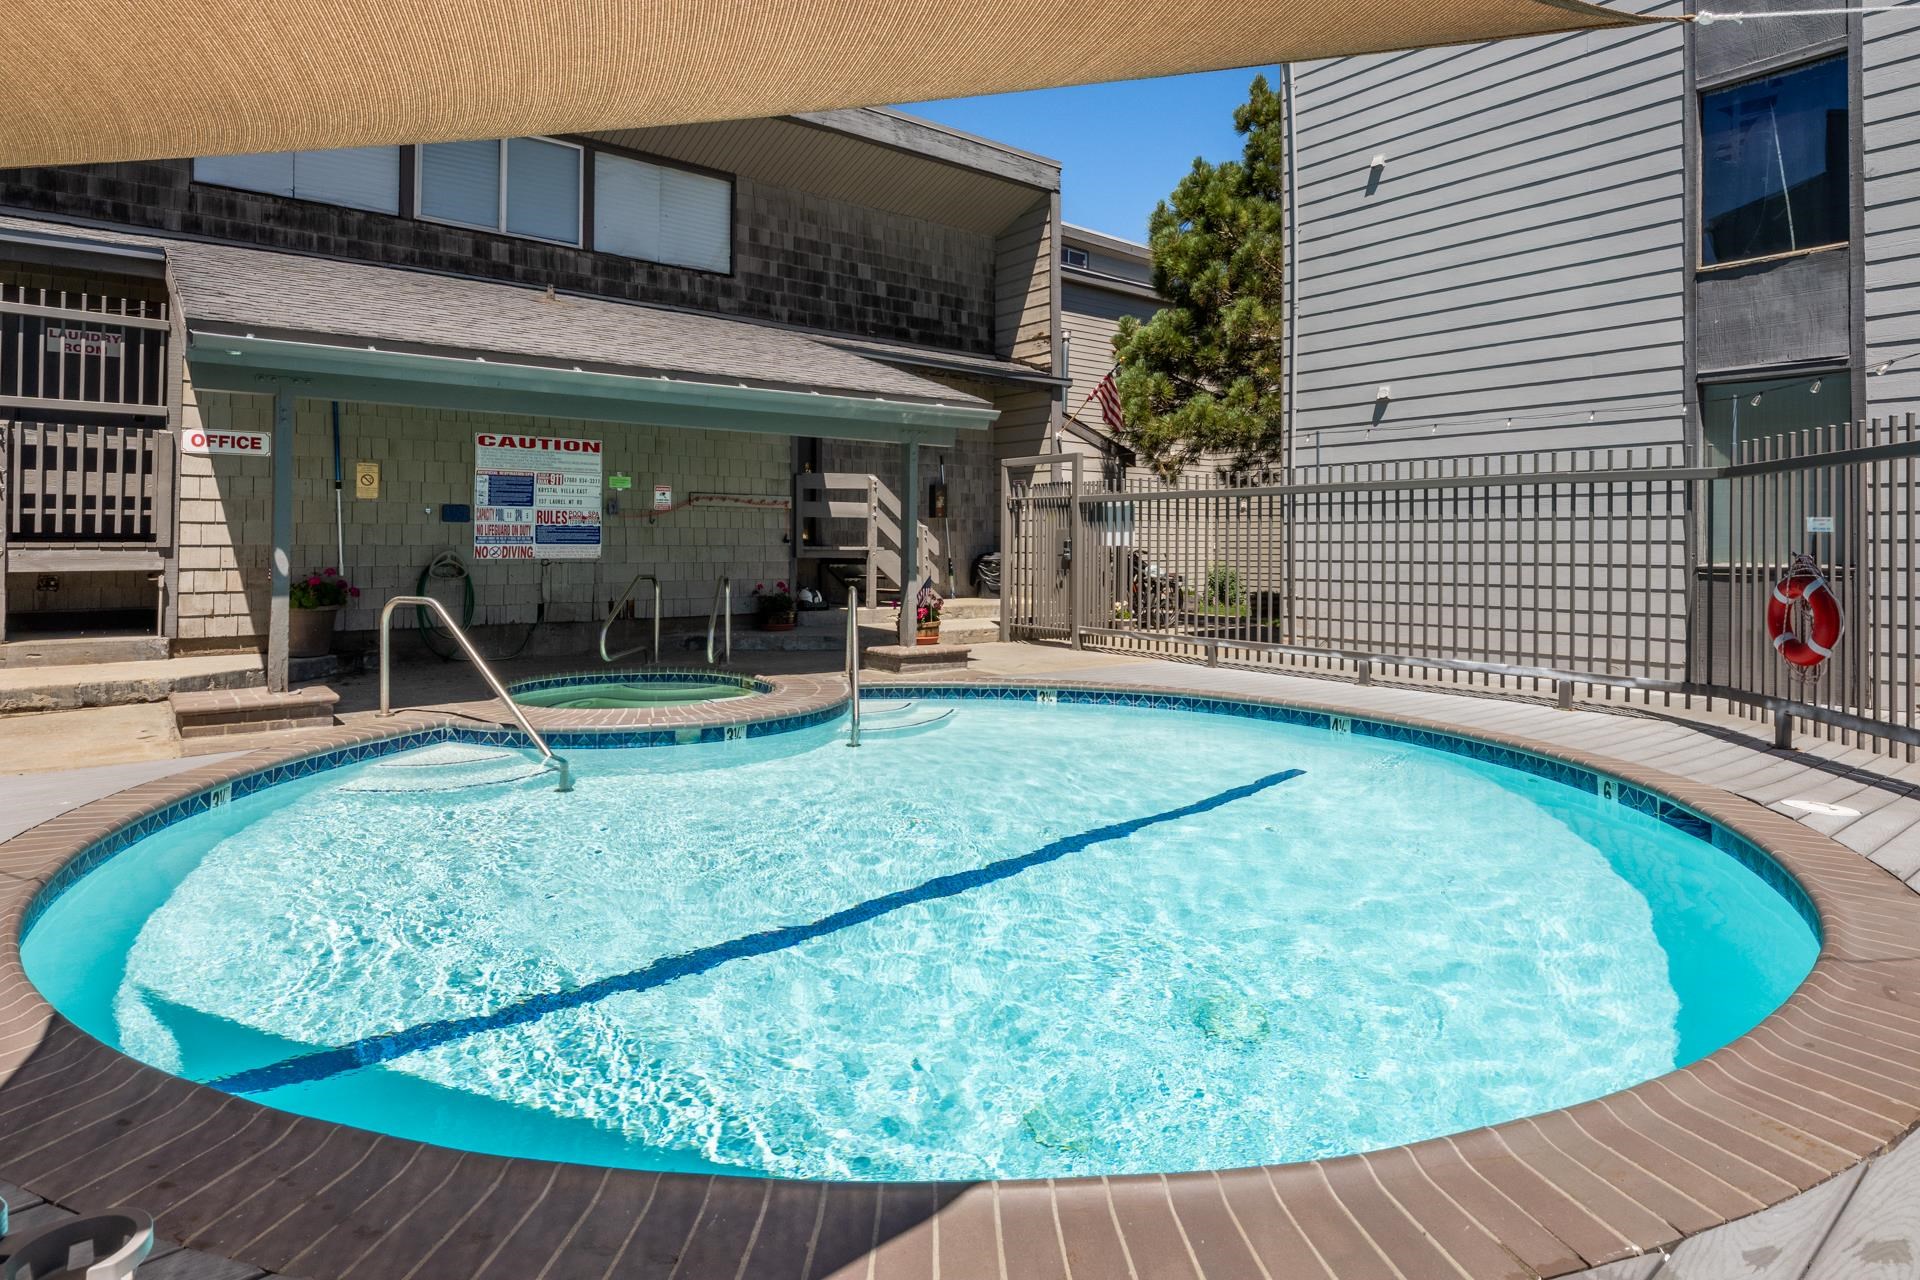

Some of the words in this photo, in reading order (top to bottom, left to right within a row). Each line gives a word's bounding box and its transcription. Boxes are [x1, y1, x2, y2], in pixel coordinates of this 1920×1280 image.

[191, 433, 262, 450] OFFICE
[478, 435, 601, 453] CAUTION
[550, 473, 563, 486] 911
[476, 507, 496, 521] CAPACITY
[536, 510, 568, 524] RULES
[476, 524, 484, 536] NO
[484, 524, 511, 536] LIFEGUARD
[511, 525, 519, 536] ON
[519, 525, 532, 537] DUTY
[475, 545, 489, 559] NO
[501, 546, 534, 559] DIVING
